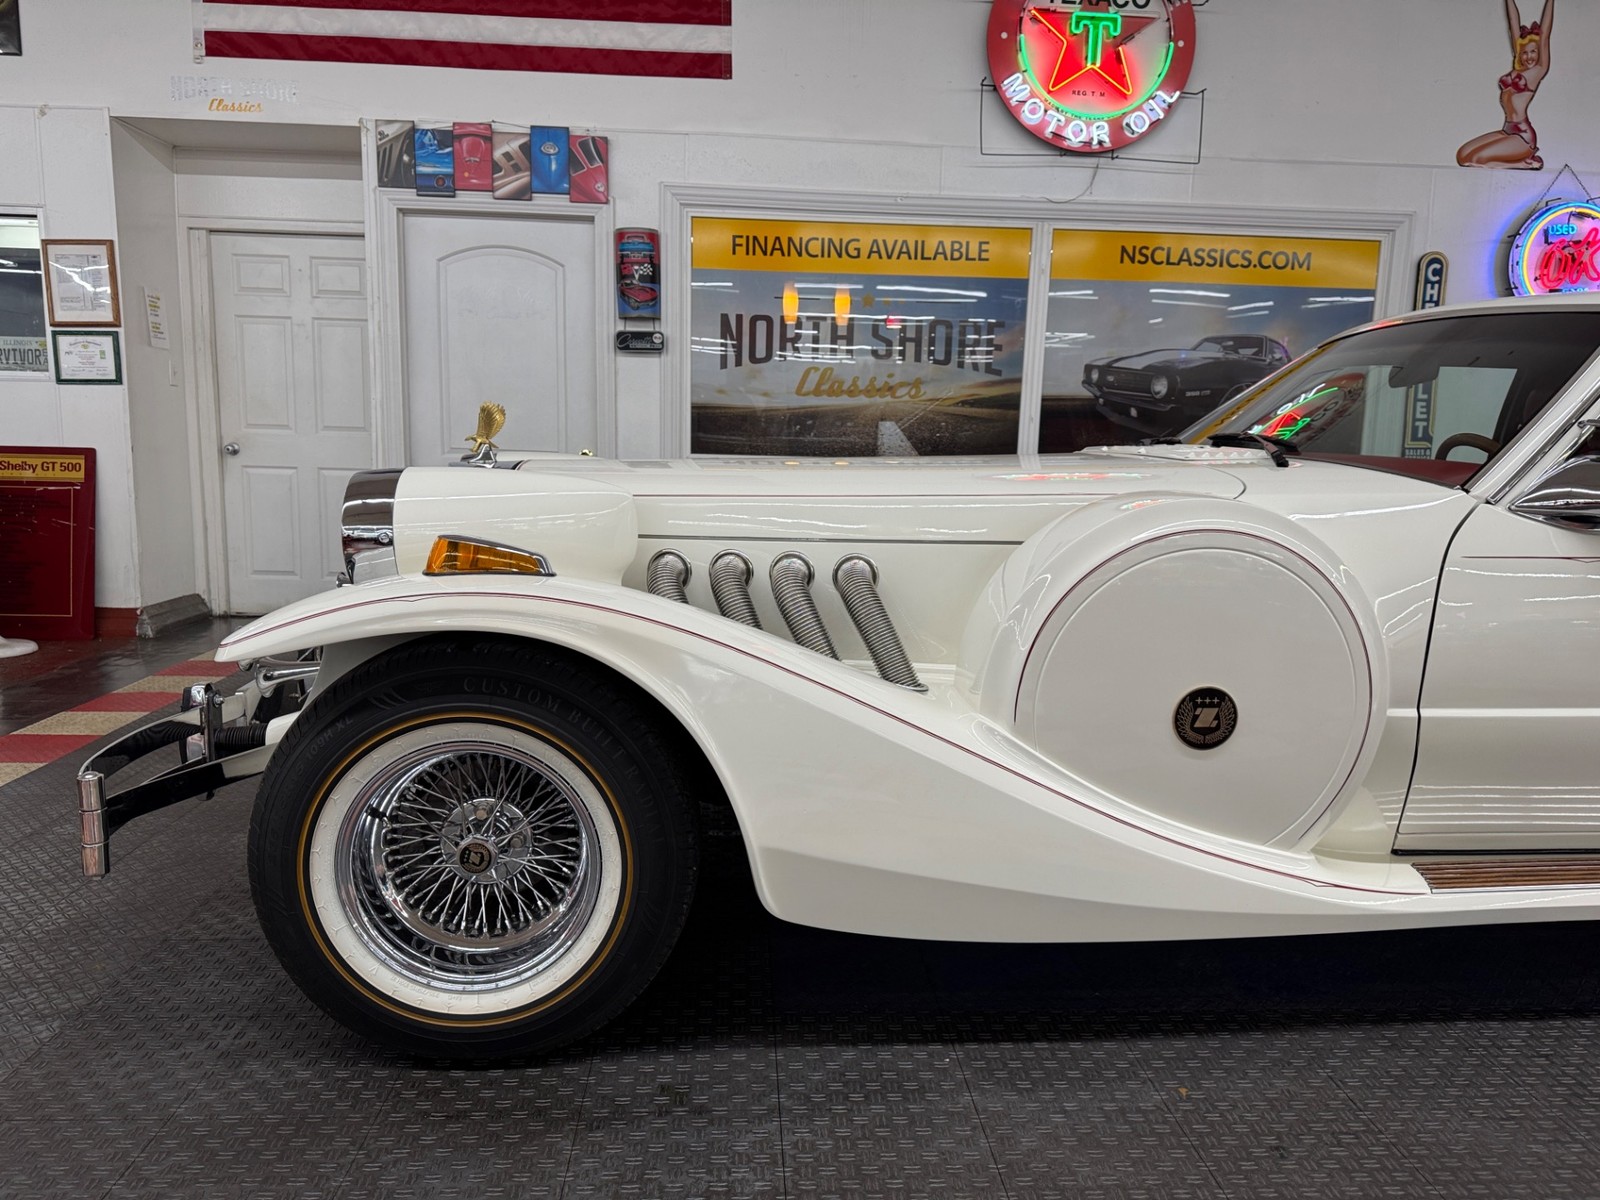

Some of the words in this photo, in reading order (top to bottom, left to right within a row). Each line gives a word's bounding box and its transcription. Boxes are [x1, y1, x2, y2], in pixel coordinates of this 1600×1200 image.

[208, 98, 264, 113] Classics
[1001, 72, 1112, 149] MOTOR
[1123, 90, 1180, 137] OIL
[1548, 224, 1577, 235] USED
[731, 235, 861, 260] FINANCING
[866, 239, 991, 263] AVAILABLE
[1119, 244, 1313, 272] NSCLASSICS.COM
[719, 313, 857, 370] NORTH
[870, 318, 1007, 377] SHORE
[794, 366, 928, 400] Classics
[0, 460, 38, 473] Shelby
[41, 462, 58, 472] GT
[60, 462, 82, 472] 500
[463, 676, 560, 714] CUSTOM
[567, 707, 627, 762] BUILT
